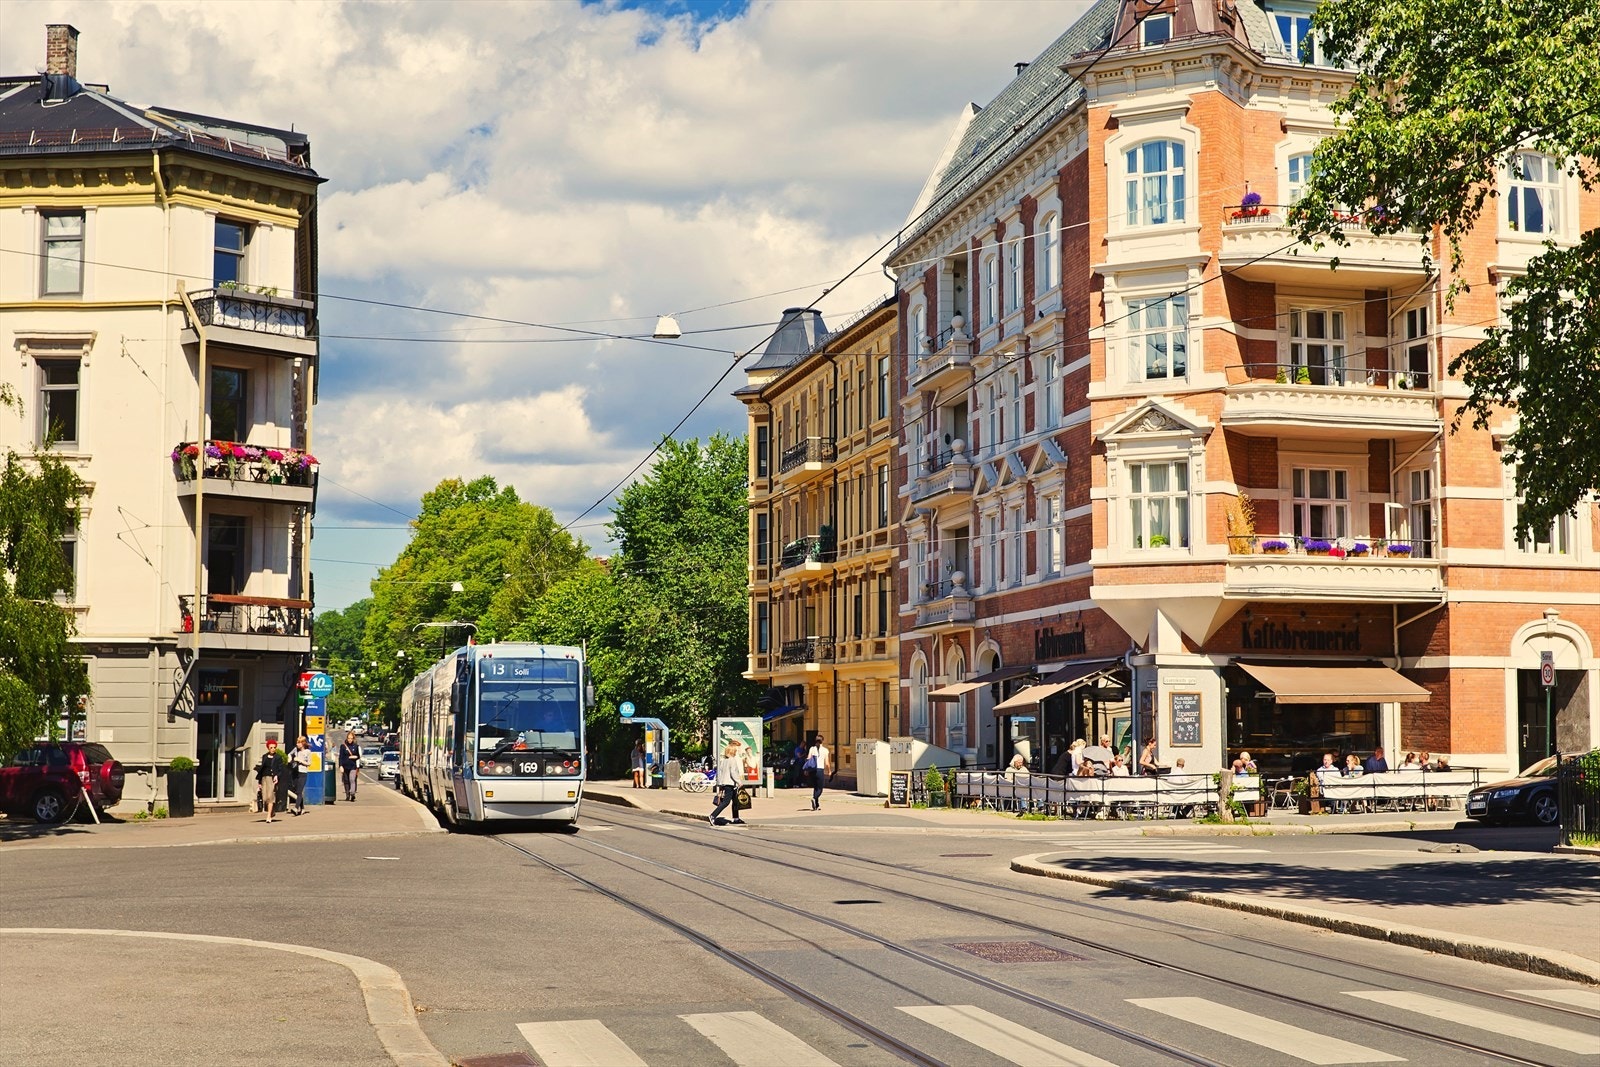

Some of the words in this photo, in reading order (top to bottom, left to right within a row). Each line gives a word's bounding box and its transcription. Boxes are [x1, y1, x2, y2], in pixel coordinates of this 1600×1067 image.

[1241, 621, 1361, 651] Kaffebrenneriet
[492, 663, 505, 675] 13
[514, 668, 530, 676] Solli
[1544, 668, 1551, 678] 30
[312, 677, 325, 688] 10
[622, 704, 631, 712] 10
[519, 762, 538, 773] 169
